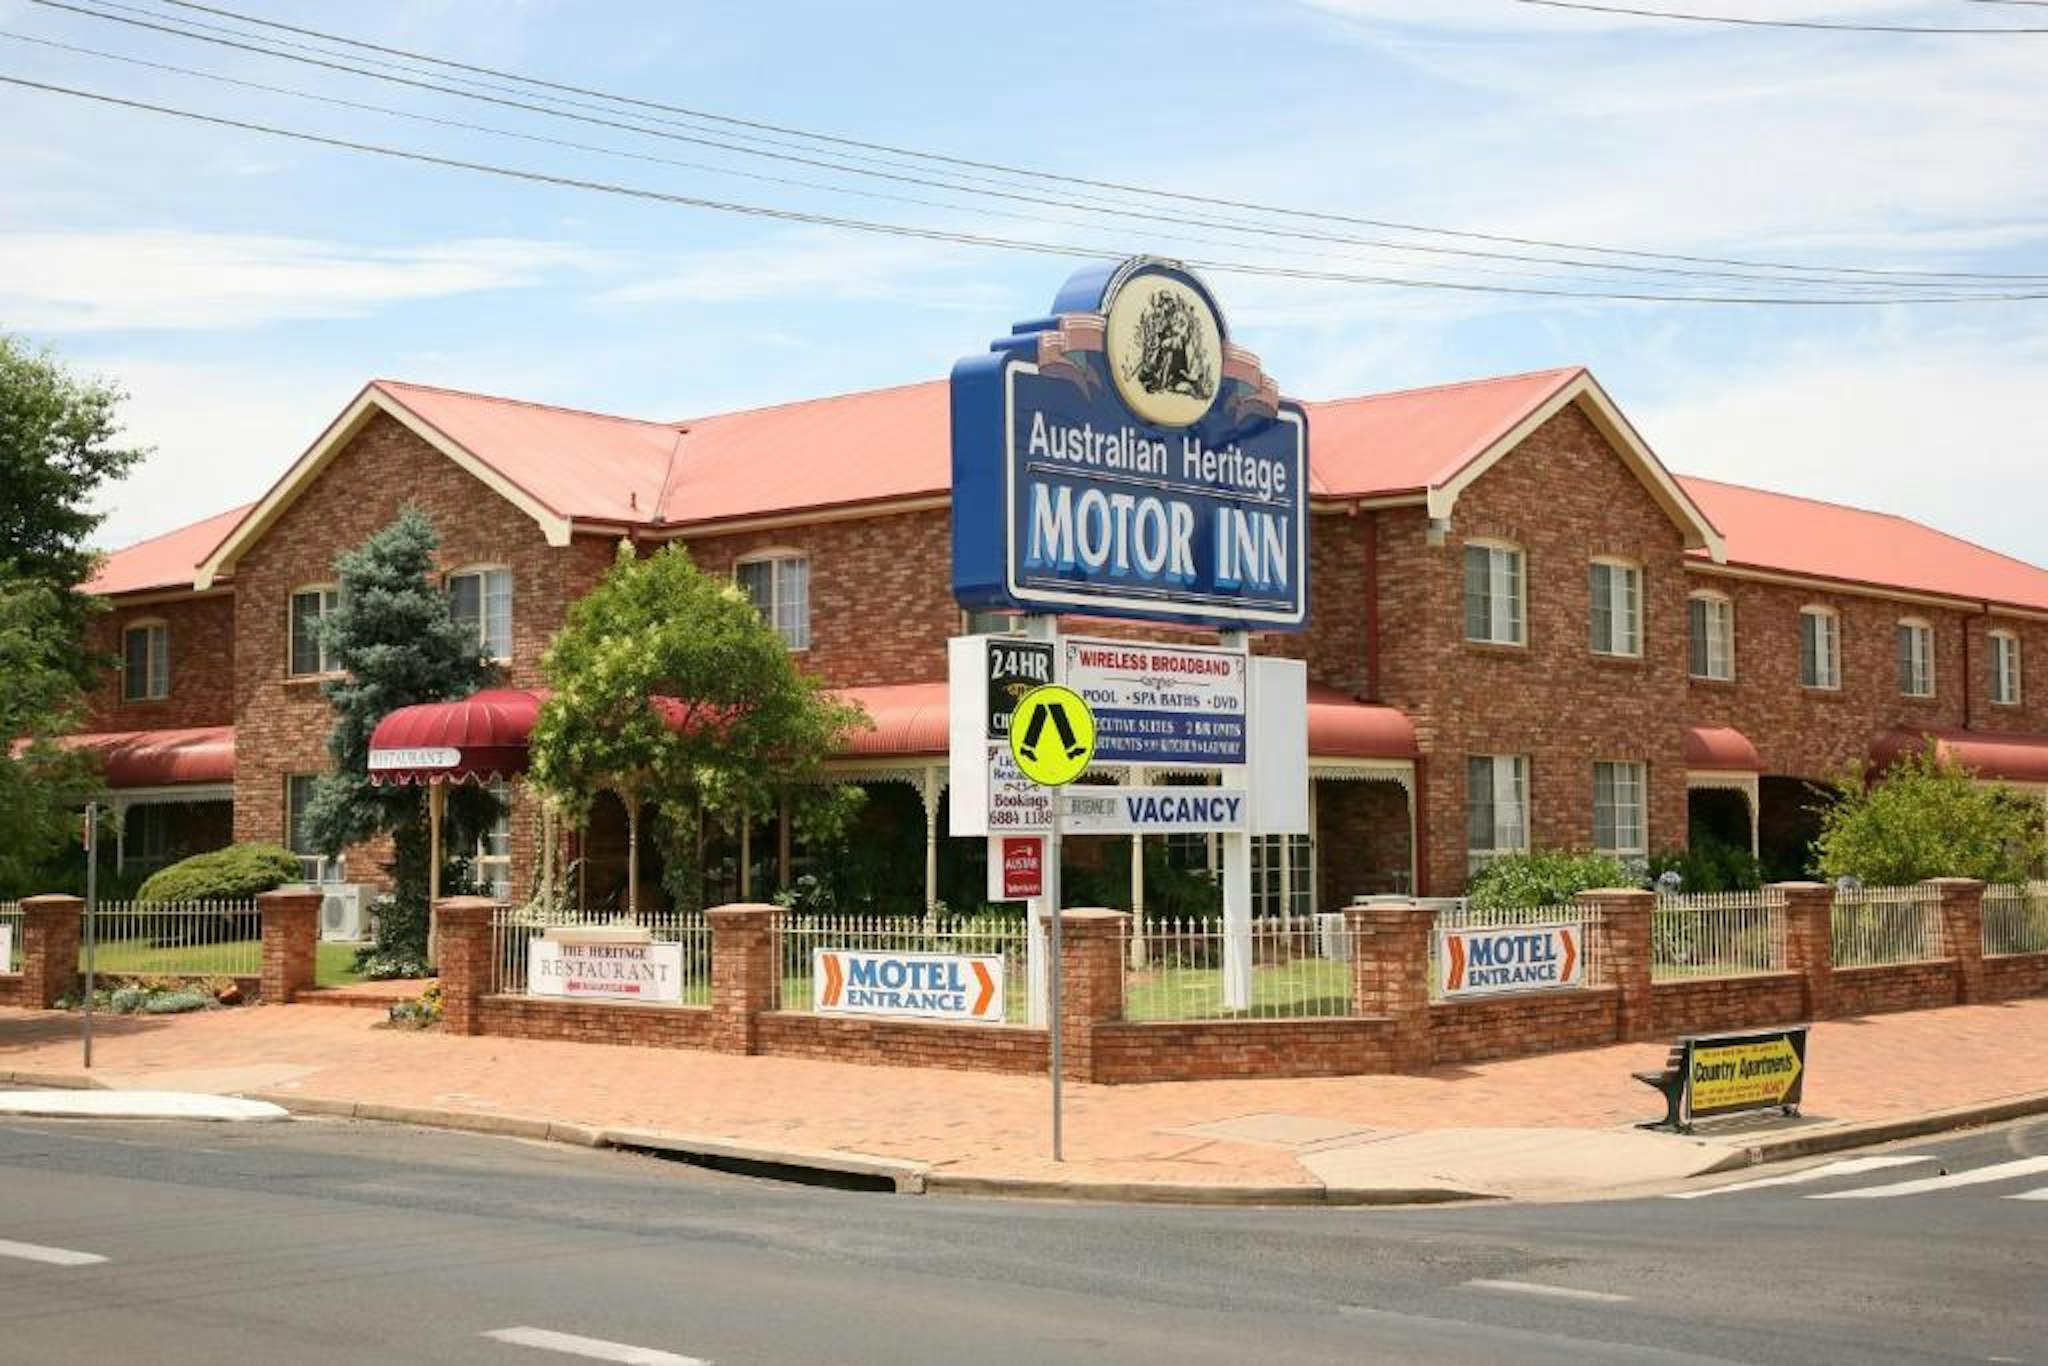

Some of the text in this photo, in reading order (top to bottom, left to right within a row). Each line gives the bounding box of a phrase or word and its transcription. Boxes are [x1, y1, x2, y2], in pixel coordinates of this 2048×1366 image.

[1029, 411, 1286, 500] Australian Heritage
[1027, 482, 1289, 590] MOTOR INN
[991, 649, 1049, 682] 24HR
[1080, 650, 1230, 676] WIRELESS BROADBAND
[1083, 690, 1238, 709] POOL SPA BATHS DVD
[1139, 720, 1174, 734] SUITES
[995, 794, 1048, 810] Bookings
[1126, 797, 1240, 823] VACANCY
[563, 945, 648, 960] THE HERITAGE
[1469, 934, 1557, 967] MOTEL
[541, 960, 669, 982] RESTAURANT
[849, 959, 966, 992] MOTEL
[1469, 964, 1557, 986] ENTRANCE
[847, 990, 966, 1011] ENTRANCE
[1695, 1053, 1793, 1083] Country Apartments
